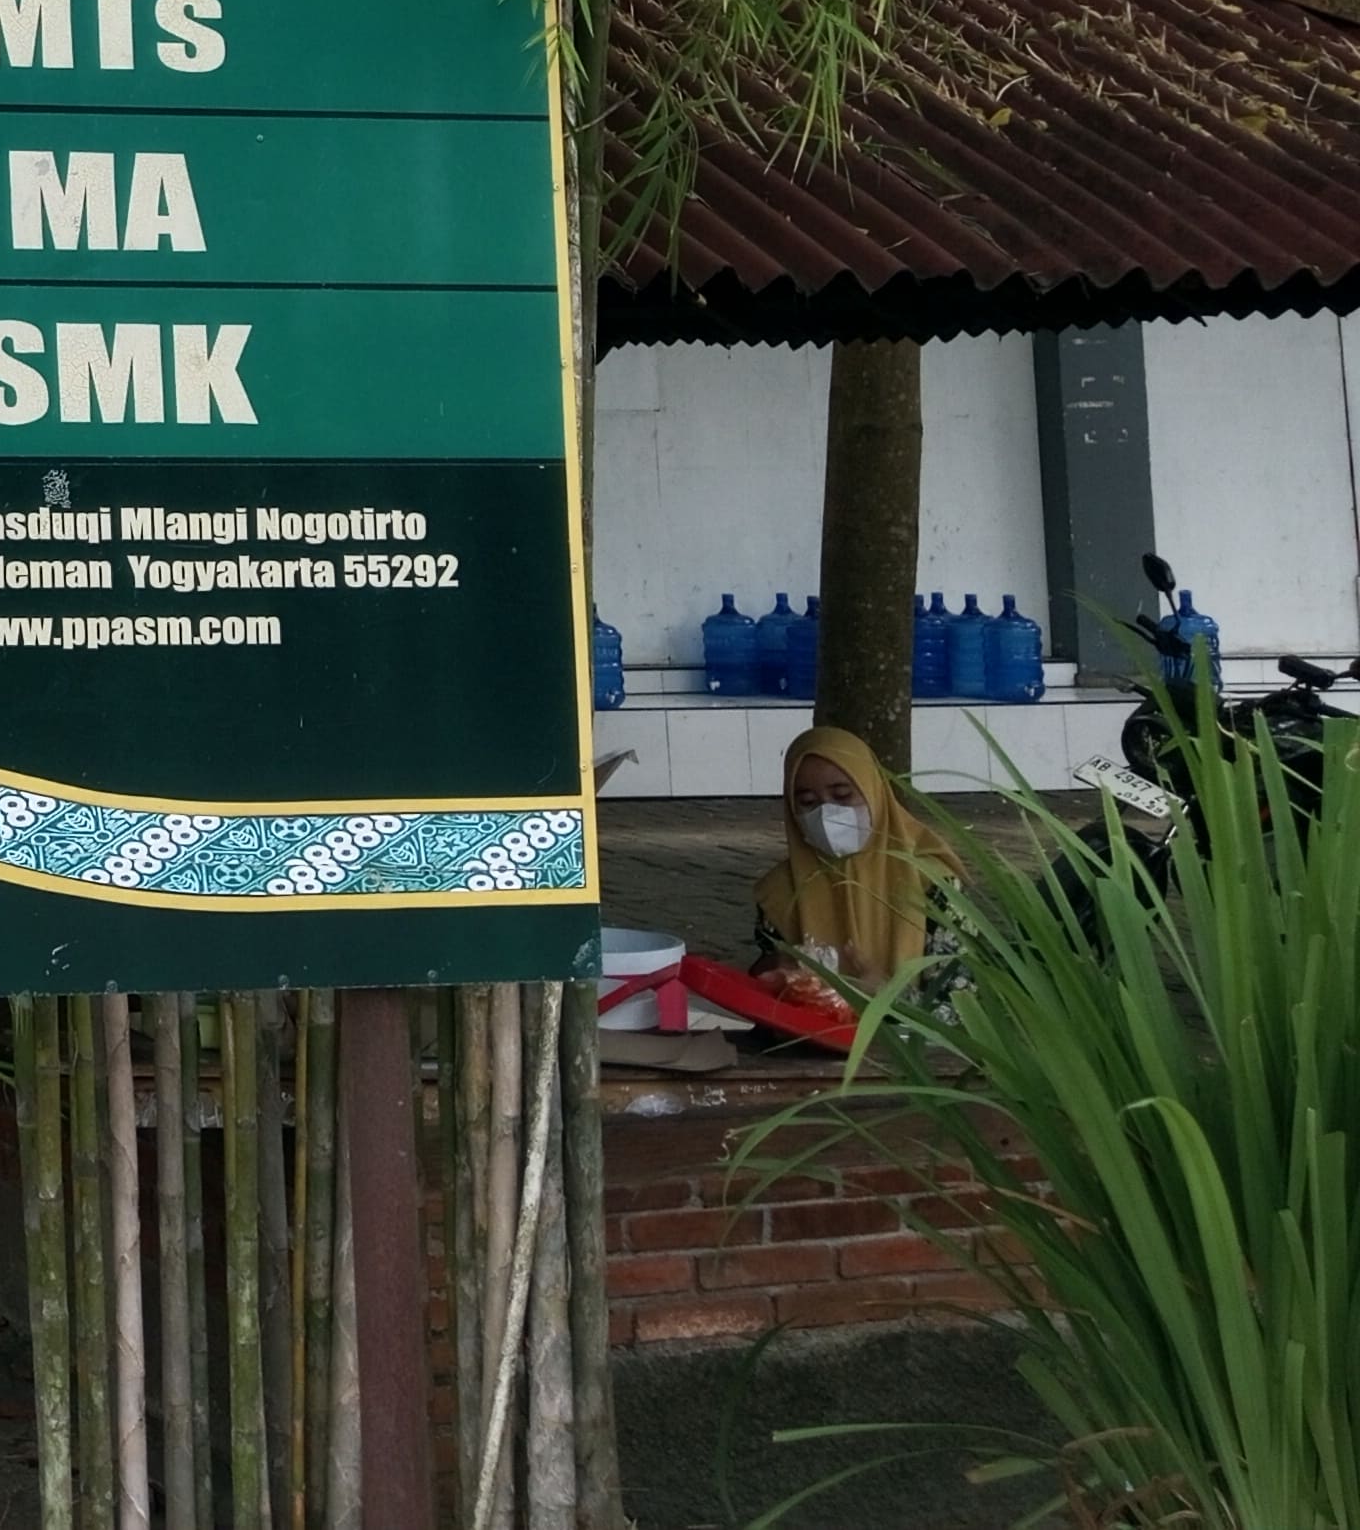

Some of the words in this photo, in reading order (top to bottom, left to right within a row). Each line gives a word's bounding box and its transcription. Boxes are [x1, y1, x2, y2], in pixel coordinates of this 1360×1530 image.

[8, 150, 207, 252] MA
[120, 507, 248, 545] Mlangi
[256, 507, 427, 545] Nogotirto
[127, 555, 336, 593] Yogyakarta
[343, 554, 460, 588] 55292
[1090, 758, 1112, 772] AB
